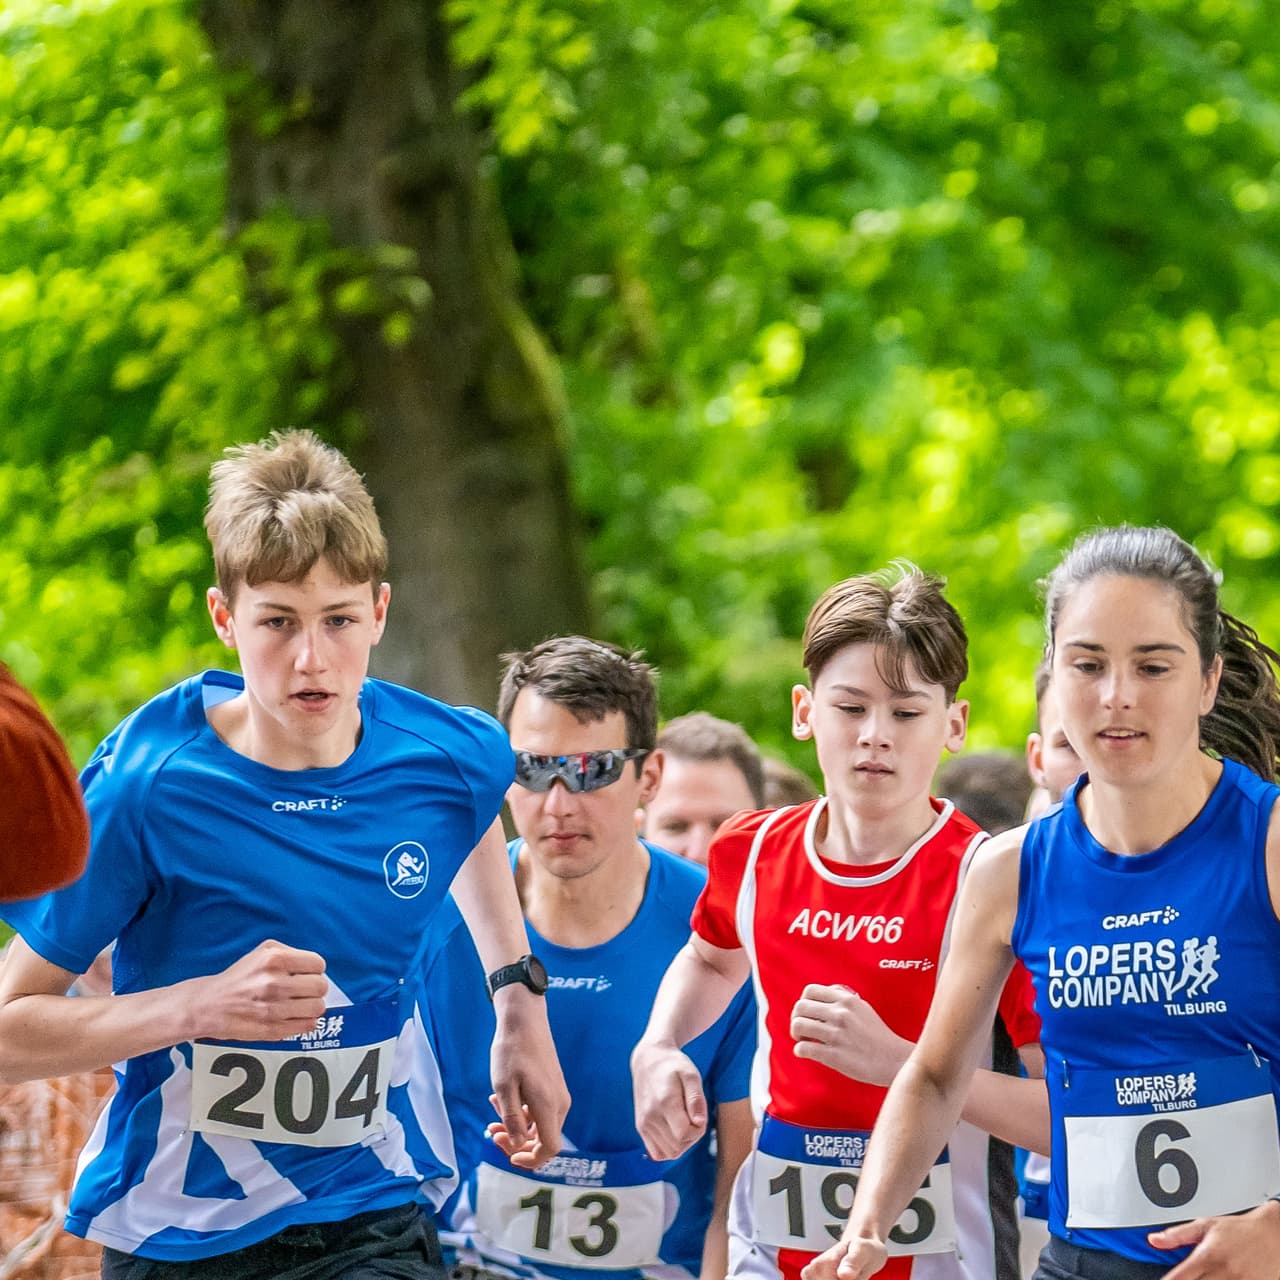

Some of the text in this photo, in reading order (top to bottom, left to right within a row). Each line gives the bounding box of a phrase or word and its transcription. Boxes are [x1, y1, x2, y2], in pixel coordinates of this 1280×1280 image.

[272, 799, 329, 812] CRAFT
[787, 908, 905, 943] ACW'66
[1102, 910, 1163, 930] CRAFT
[879, 959, 922, 969] CRAFT
[1048, 938, 1176, 977] LOPERS
[1048, 970, 1176, 1009] COMPANY
[1164, 1000, 1227, 1016] TILBURG
[301, 1039, 340, 1050] TILBURG
[207, 1048, 381, 1134] 204
[1115, 1075, 1176, 1092] LOPERS
[1117, 1088, 1176, 1105] COMPANY
[1152, 1099, 1198, 1112] TILBURG
[805, 1134, 863, 1148] LOPERS
[806, 1145, 864, 1158] COMPANY
[1135, 1118, 1199, 1208] 6
[519, 1186, 618, 1257] 13
